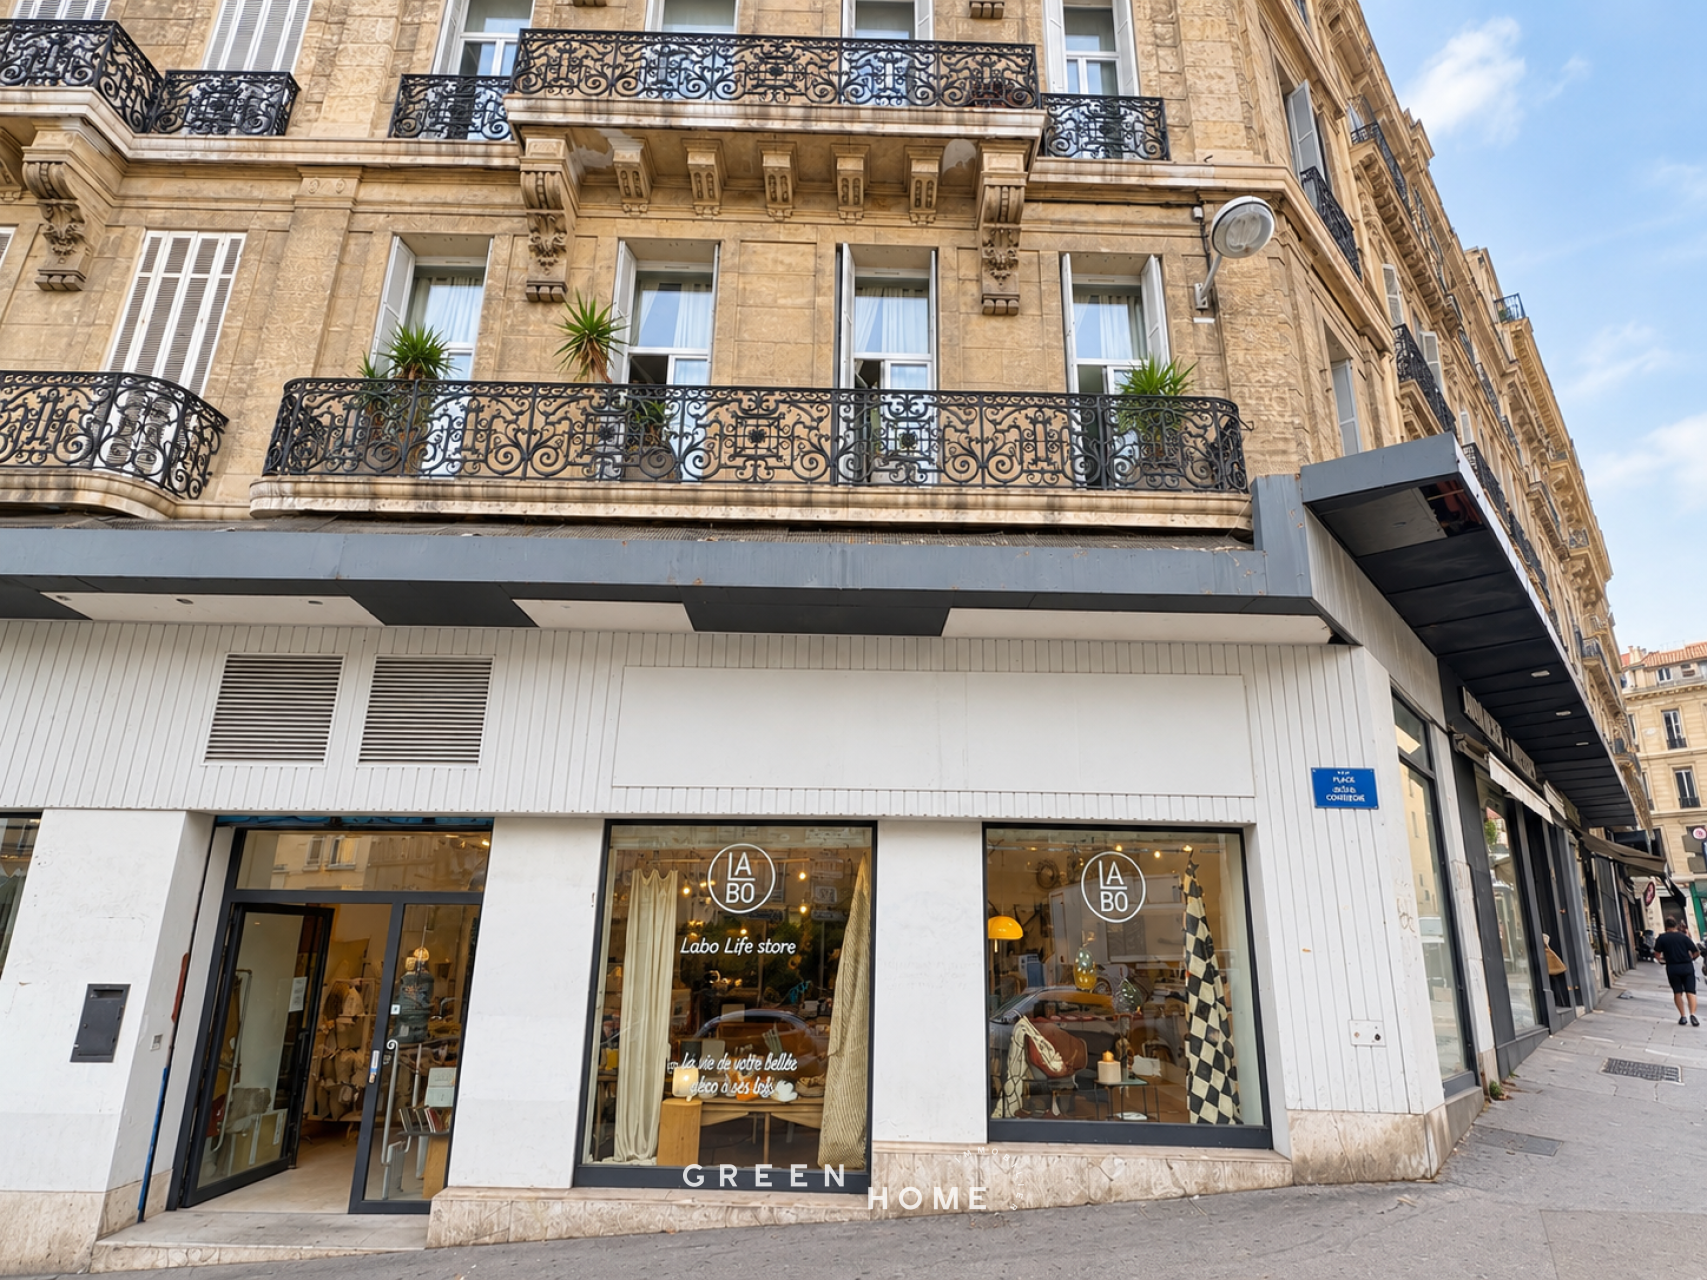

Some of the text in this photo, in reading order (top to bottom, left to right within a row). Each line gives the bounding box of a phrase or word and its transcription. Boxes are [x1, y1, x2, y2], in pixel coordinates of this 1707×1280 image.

[680, 936, 797, 956] Labo Life store
